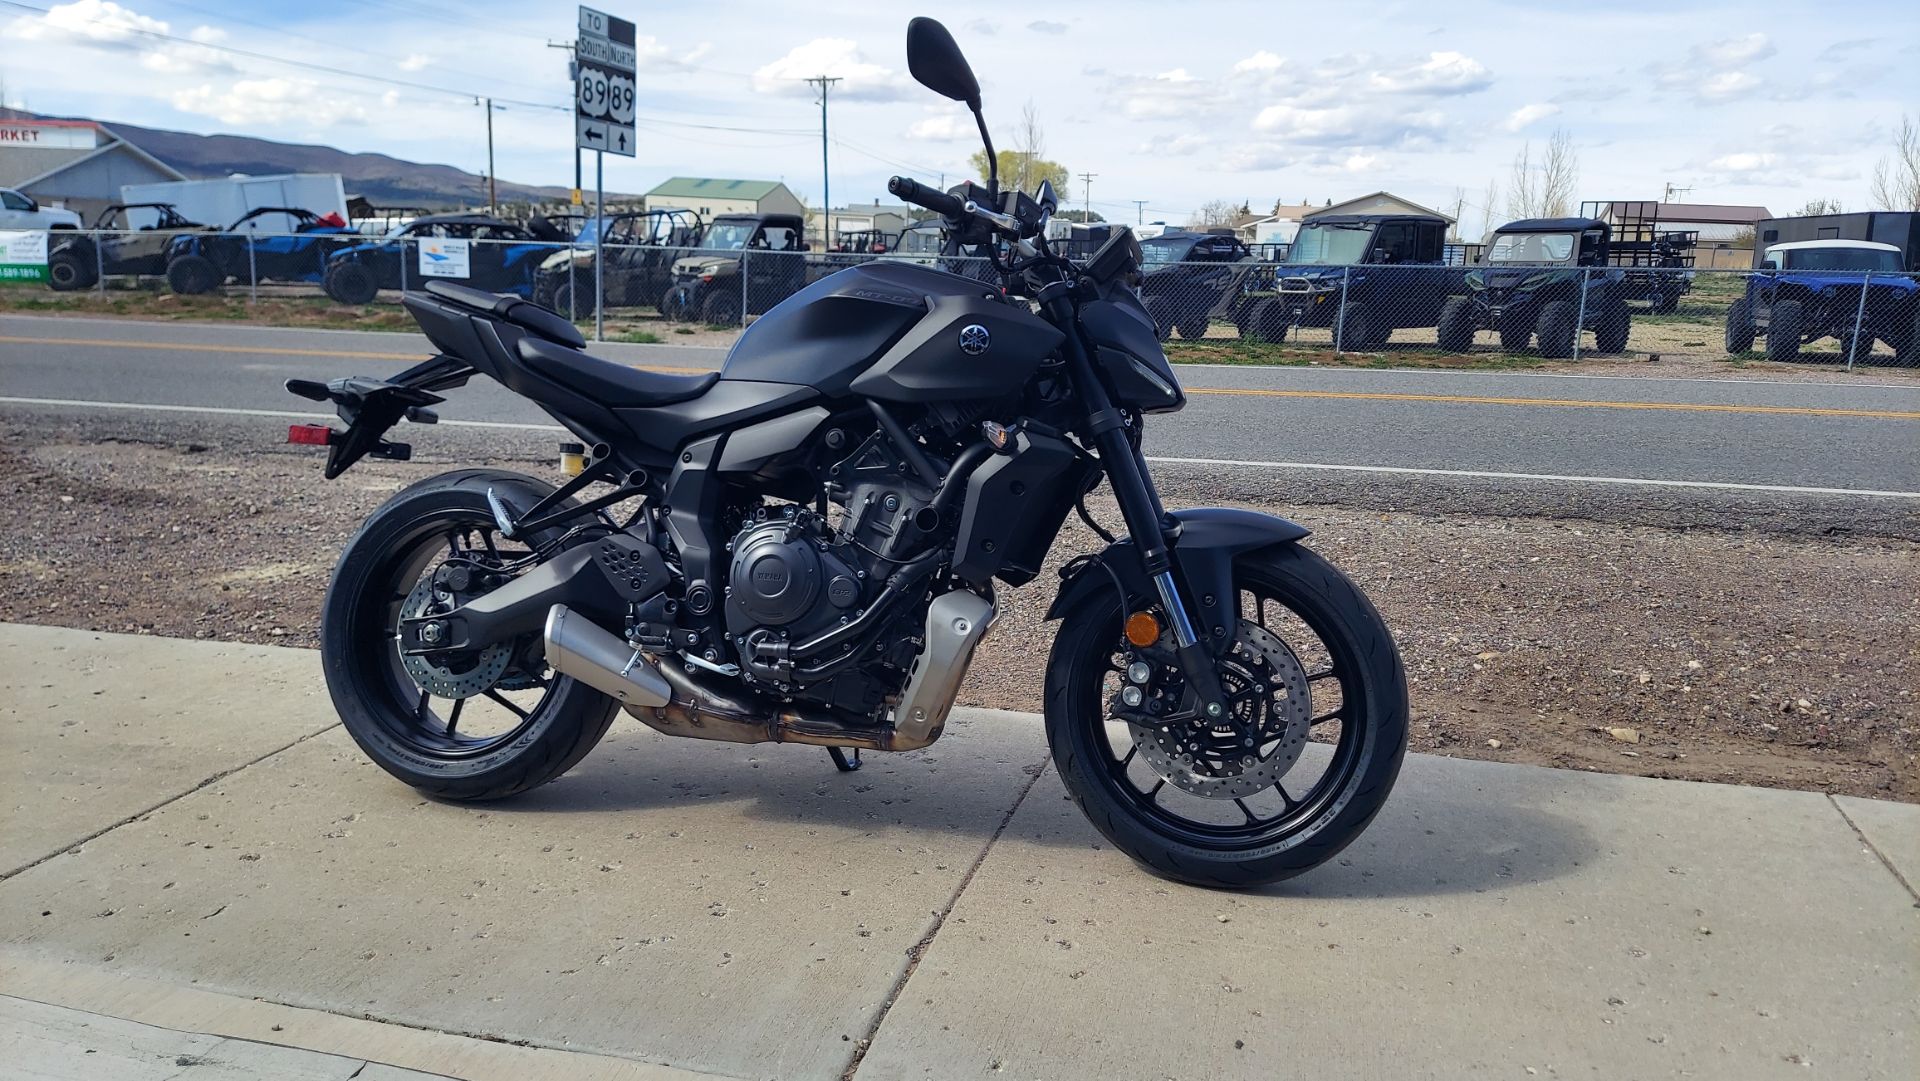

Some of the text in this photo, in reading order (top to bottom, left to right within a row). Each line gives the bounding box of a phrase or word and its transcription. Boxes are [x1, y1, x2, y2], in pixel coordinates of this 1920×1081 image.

[586, 13, 601, 30] TO
[581, 36, 608, 60] SOUTH
[610, 45, 635, 65] NORTH
[582, 76, 606, 105] 89
[611, 85, 633, 112] 89
[0, 129, 40, 141] RKET
